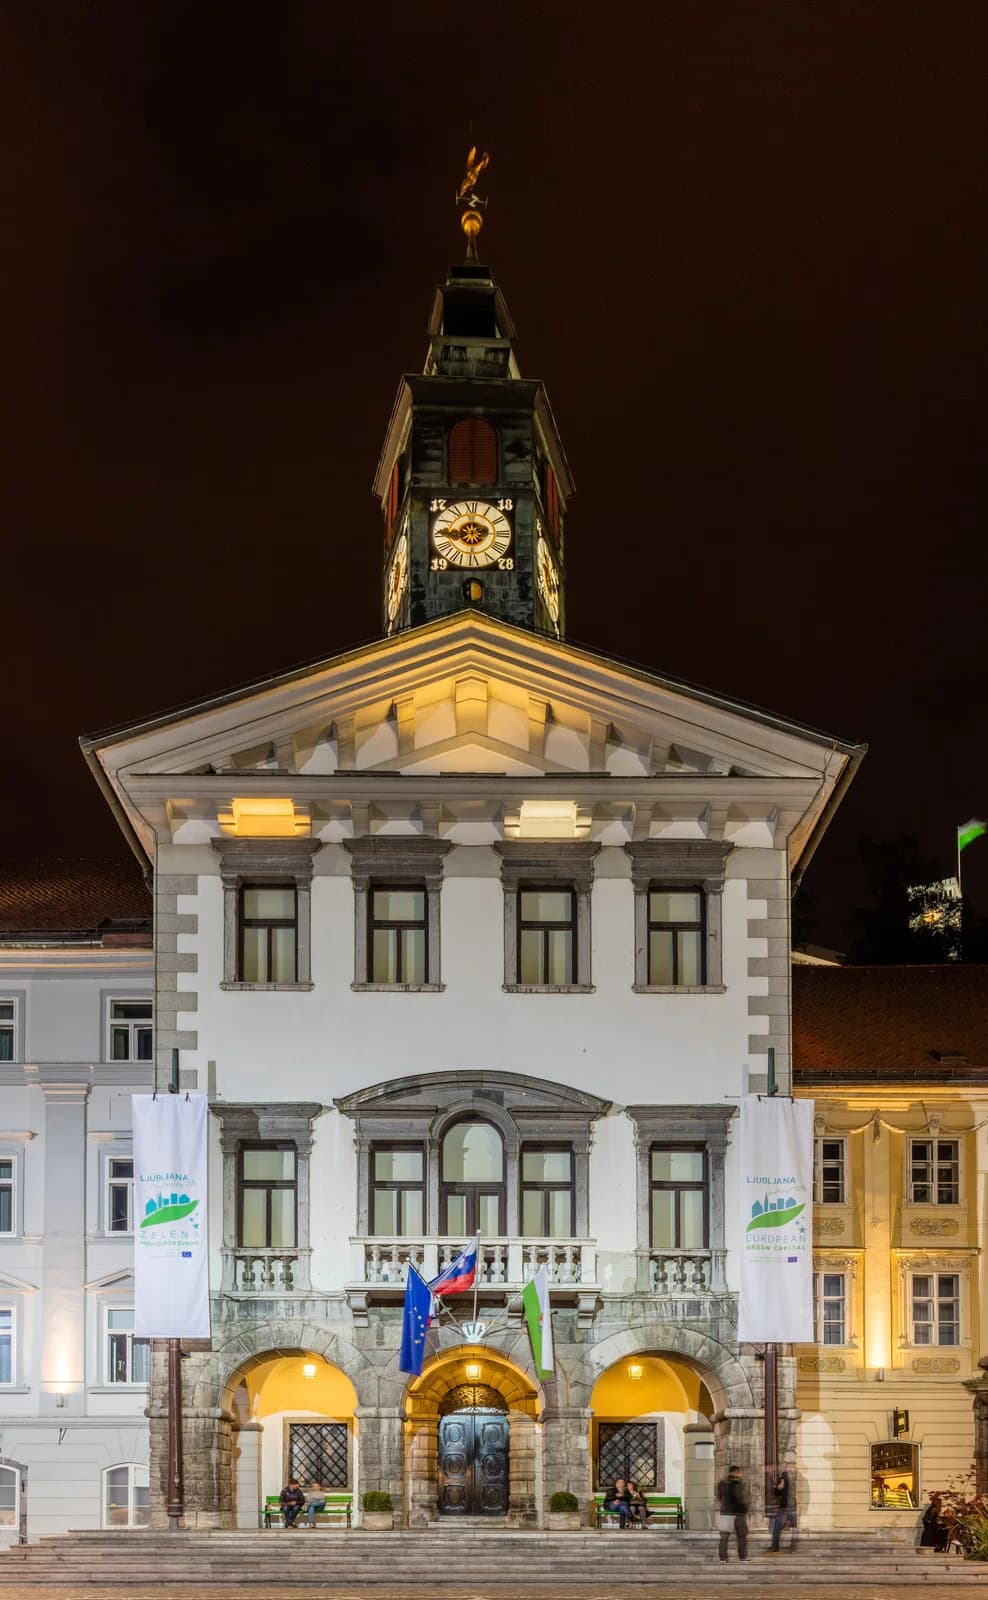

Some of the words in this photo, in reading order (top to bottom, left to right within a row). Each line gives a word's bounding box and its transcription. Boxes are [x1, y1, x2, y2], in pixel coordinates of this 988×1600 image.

[496, 498, 513, 511] 18
[430, 558, 448, 571] 19
[746, 1176, 796, 1185] LJUBLJANA
[139, 1230, 200, 1239] ZELENA
[745, 1233, 806, 1243] EUROPEAN
